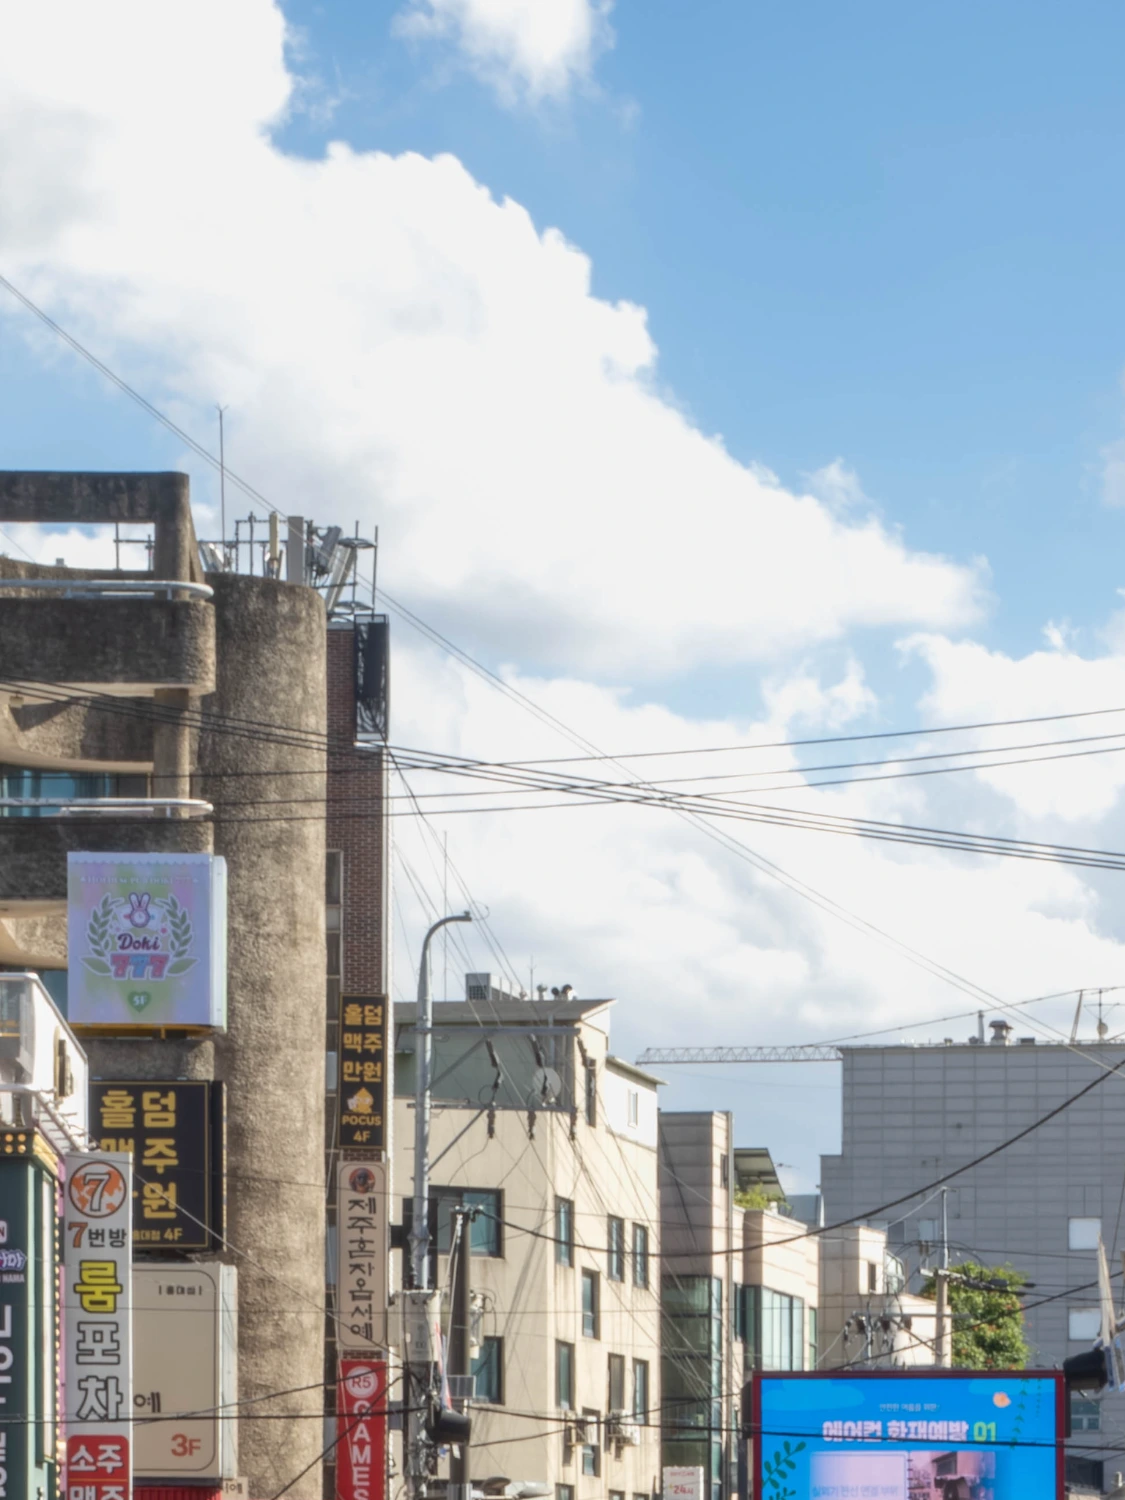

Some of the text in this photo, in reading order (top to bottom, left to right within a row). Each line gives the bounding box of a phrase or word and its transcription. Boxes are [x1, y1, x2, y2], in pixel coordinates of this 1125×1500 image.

[117, 933, 160, 950] Doki
[110, 953, 170, 979] 777
[344, 1003, 383, 1026] 홀덤
[343, 1032, 383, 1054] 맥주
[343, 1061, 382, 1082] 만원
[100, 1090, 176, 1128] 홀덤
[342, 1115, 381, 1126] POCUS
[353, 1130, 370, 1143] 4F
[68, 1221, 127, 1249] 7번방
[164, 1228, 183, 1241] 4F
[74, 1260, 123, 1421] 룸포차
[351, 1376, 371, 1389] R5
[822, 1420, 996, 1443] 에어컨 화재예방 01
[171, 1433, 201, 1457] 3F
[69, 1444, 123, 1474] 소주
